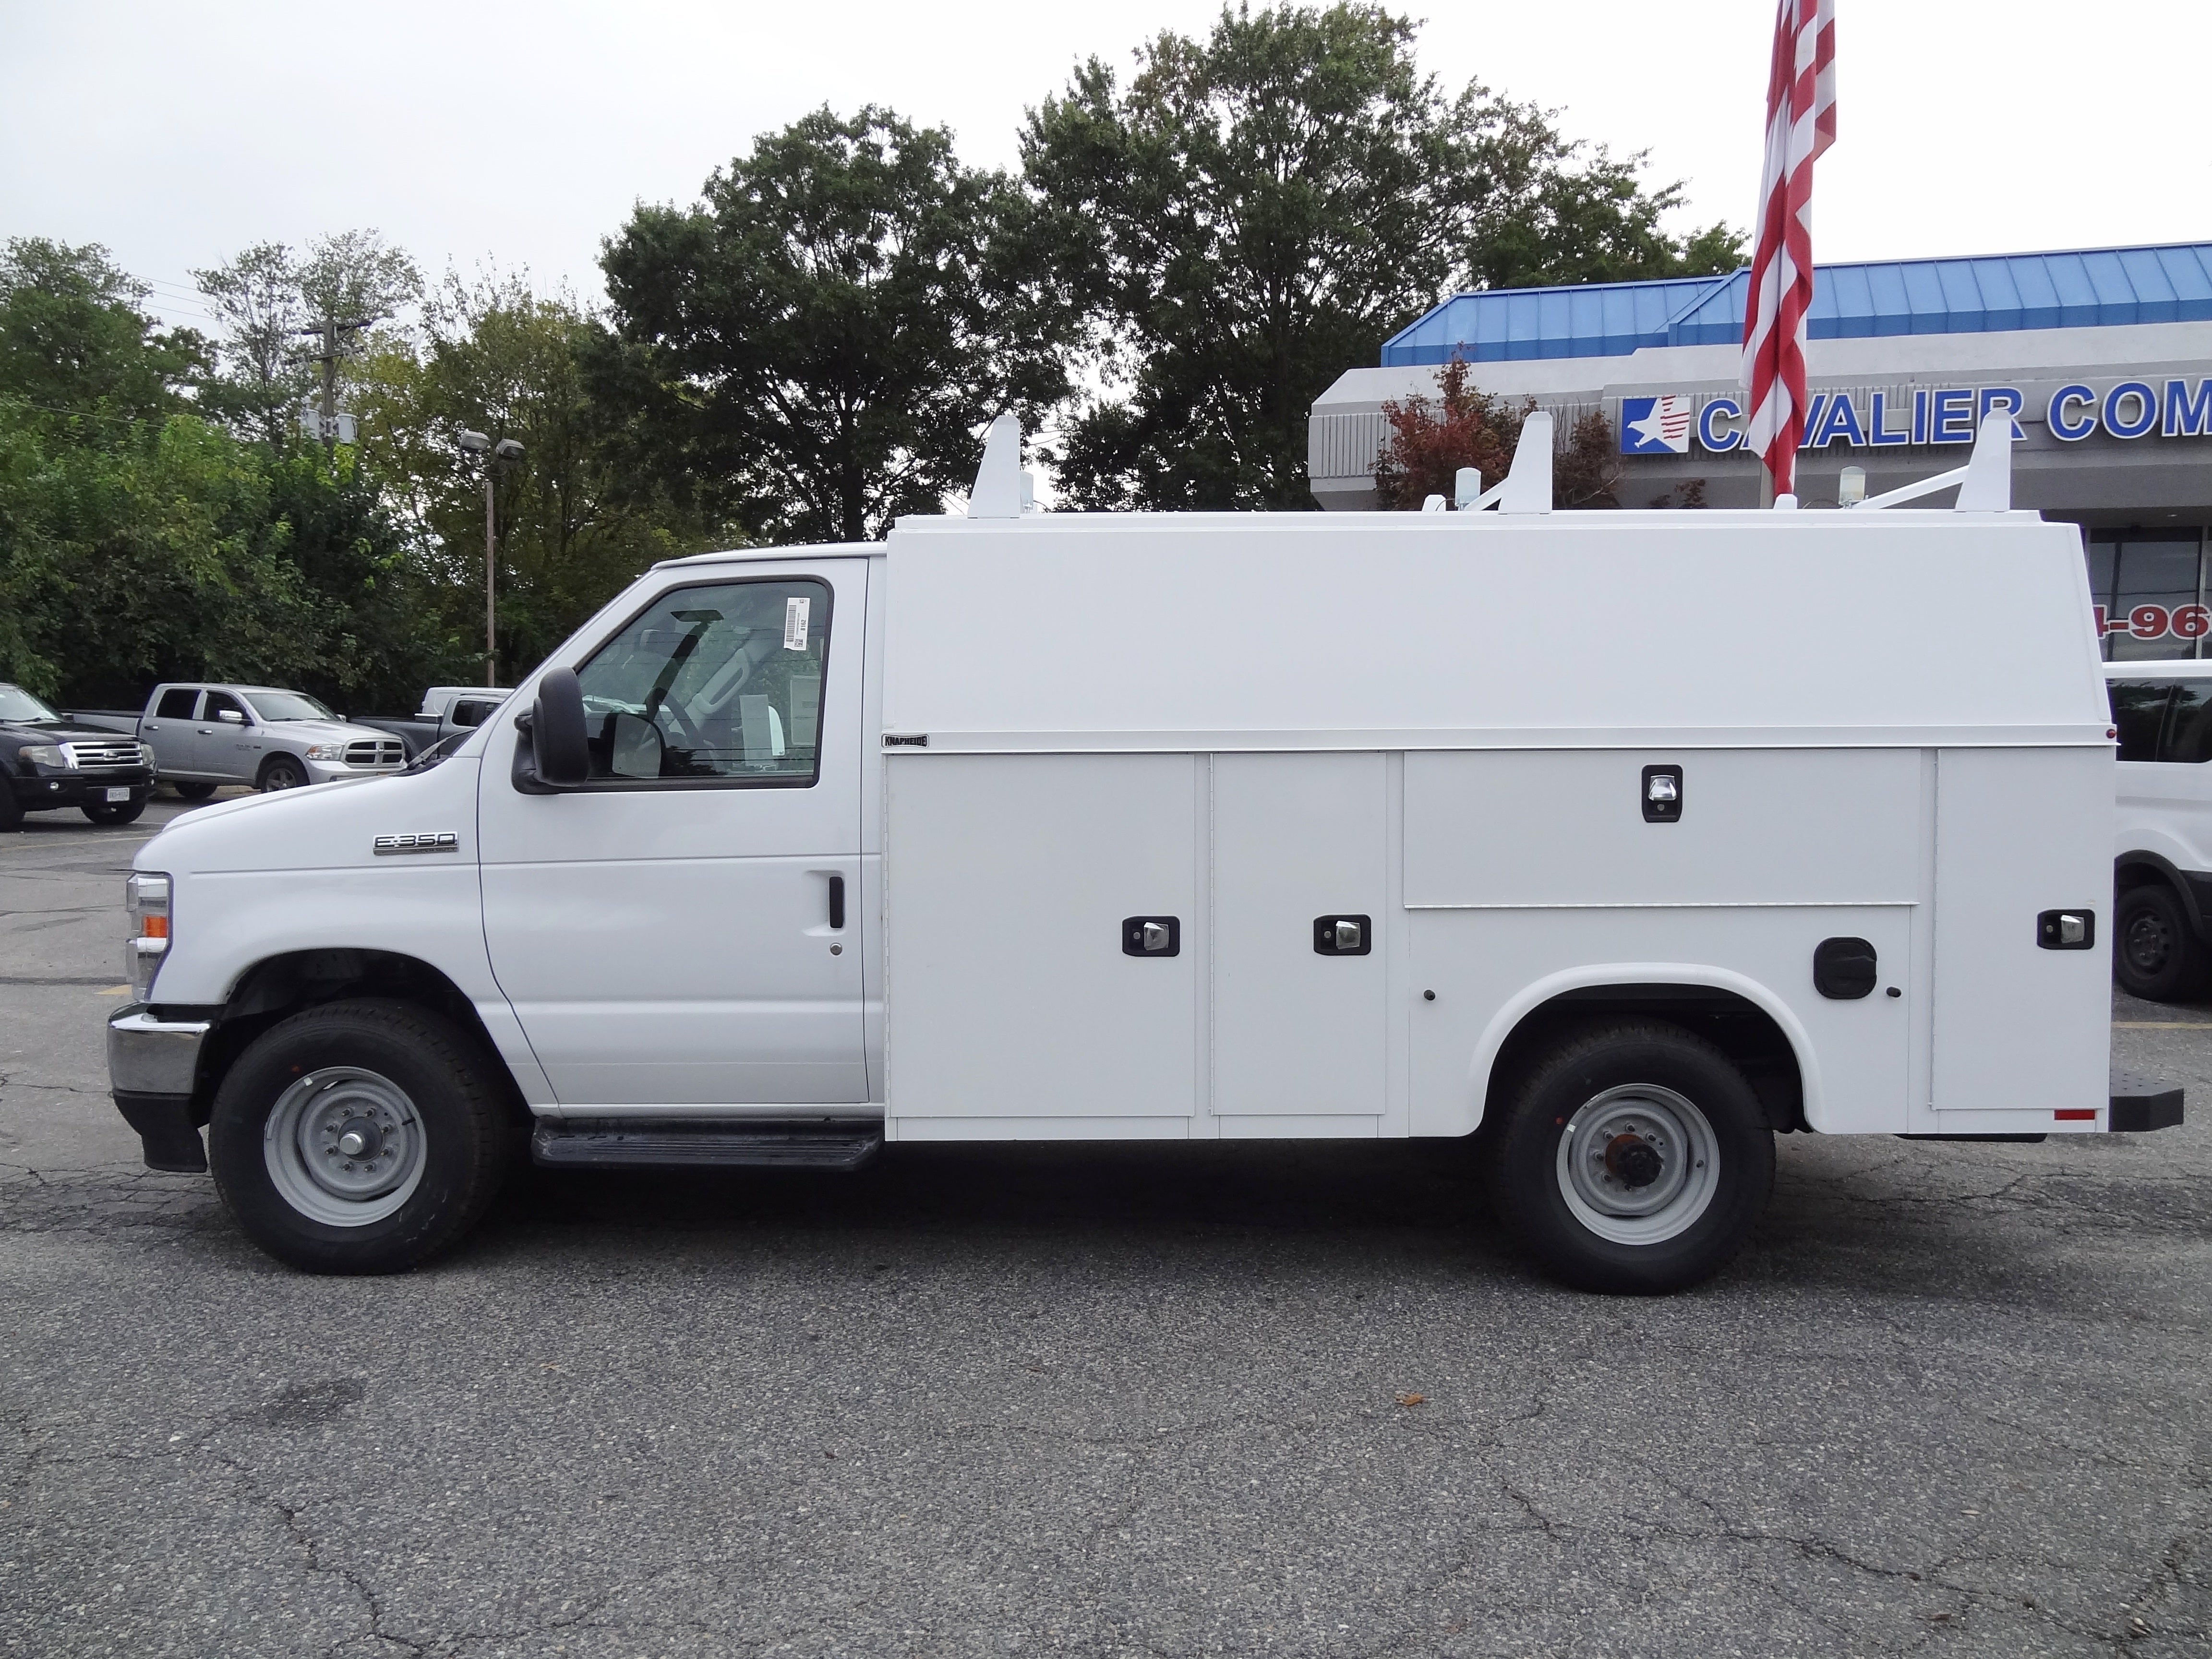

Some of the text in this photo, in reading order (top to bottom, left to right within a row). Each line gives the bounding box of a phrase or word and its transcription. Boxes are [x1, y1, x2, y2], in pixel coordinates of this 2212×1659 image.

[1697, 378, 2212, 452] CALIER COM
[885, 735, 928, 747] KNAPHEIDE
[374, 833, 457, 848] E-350
